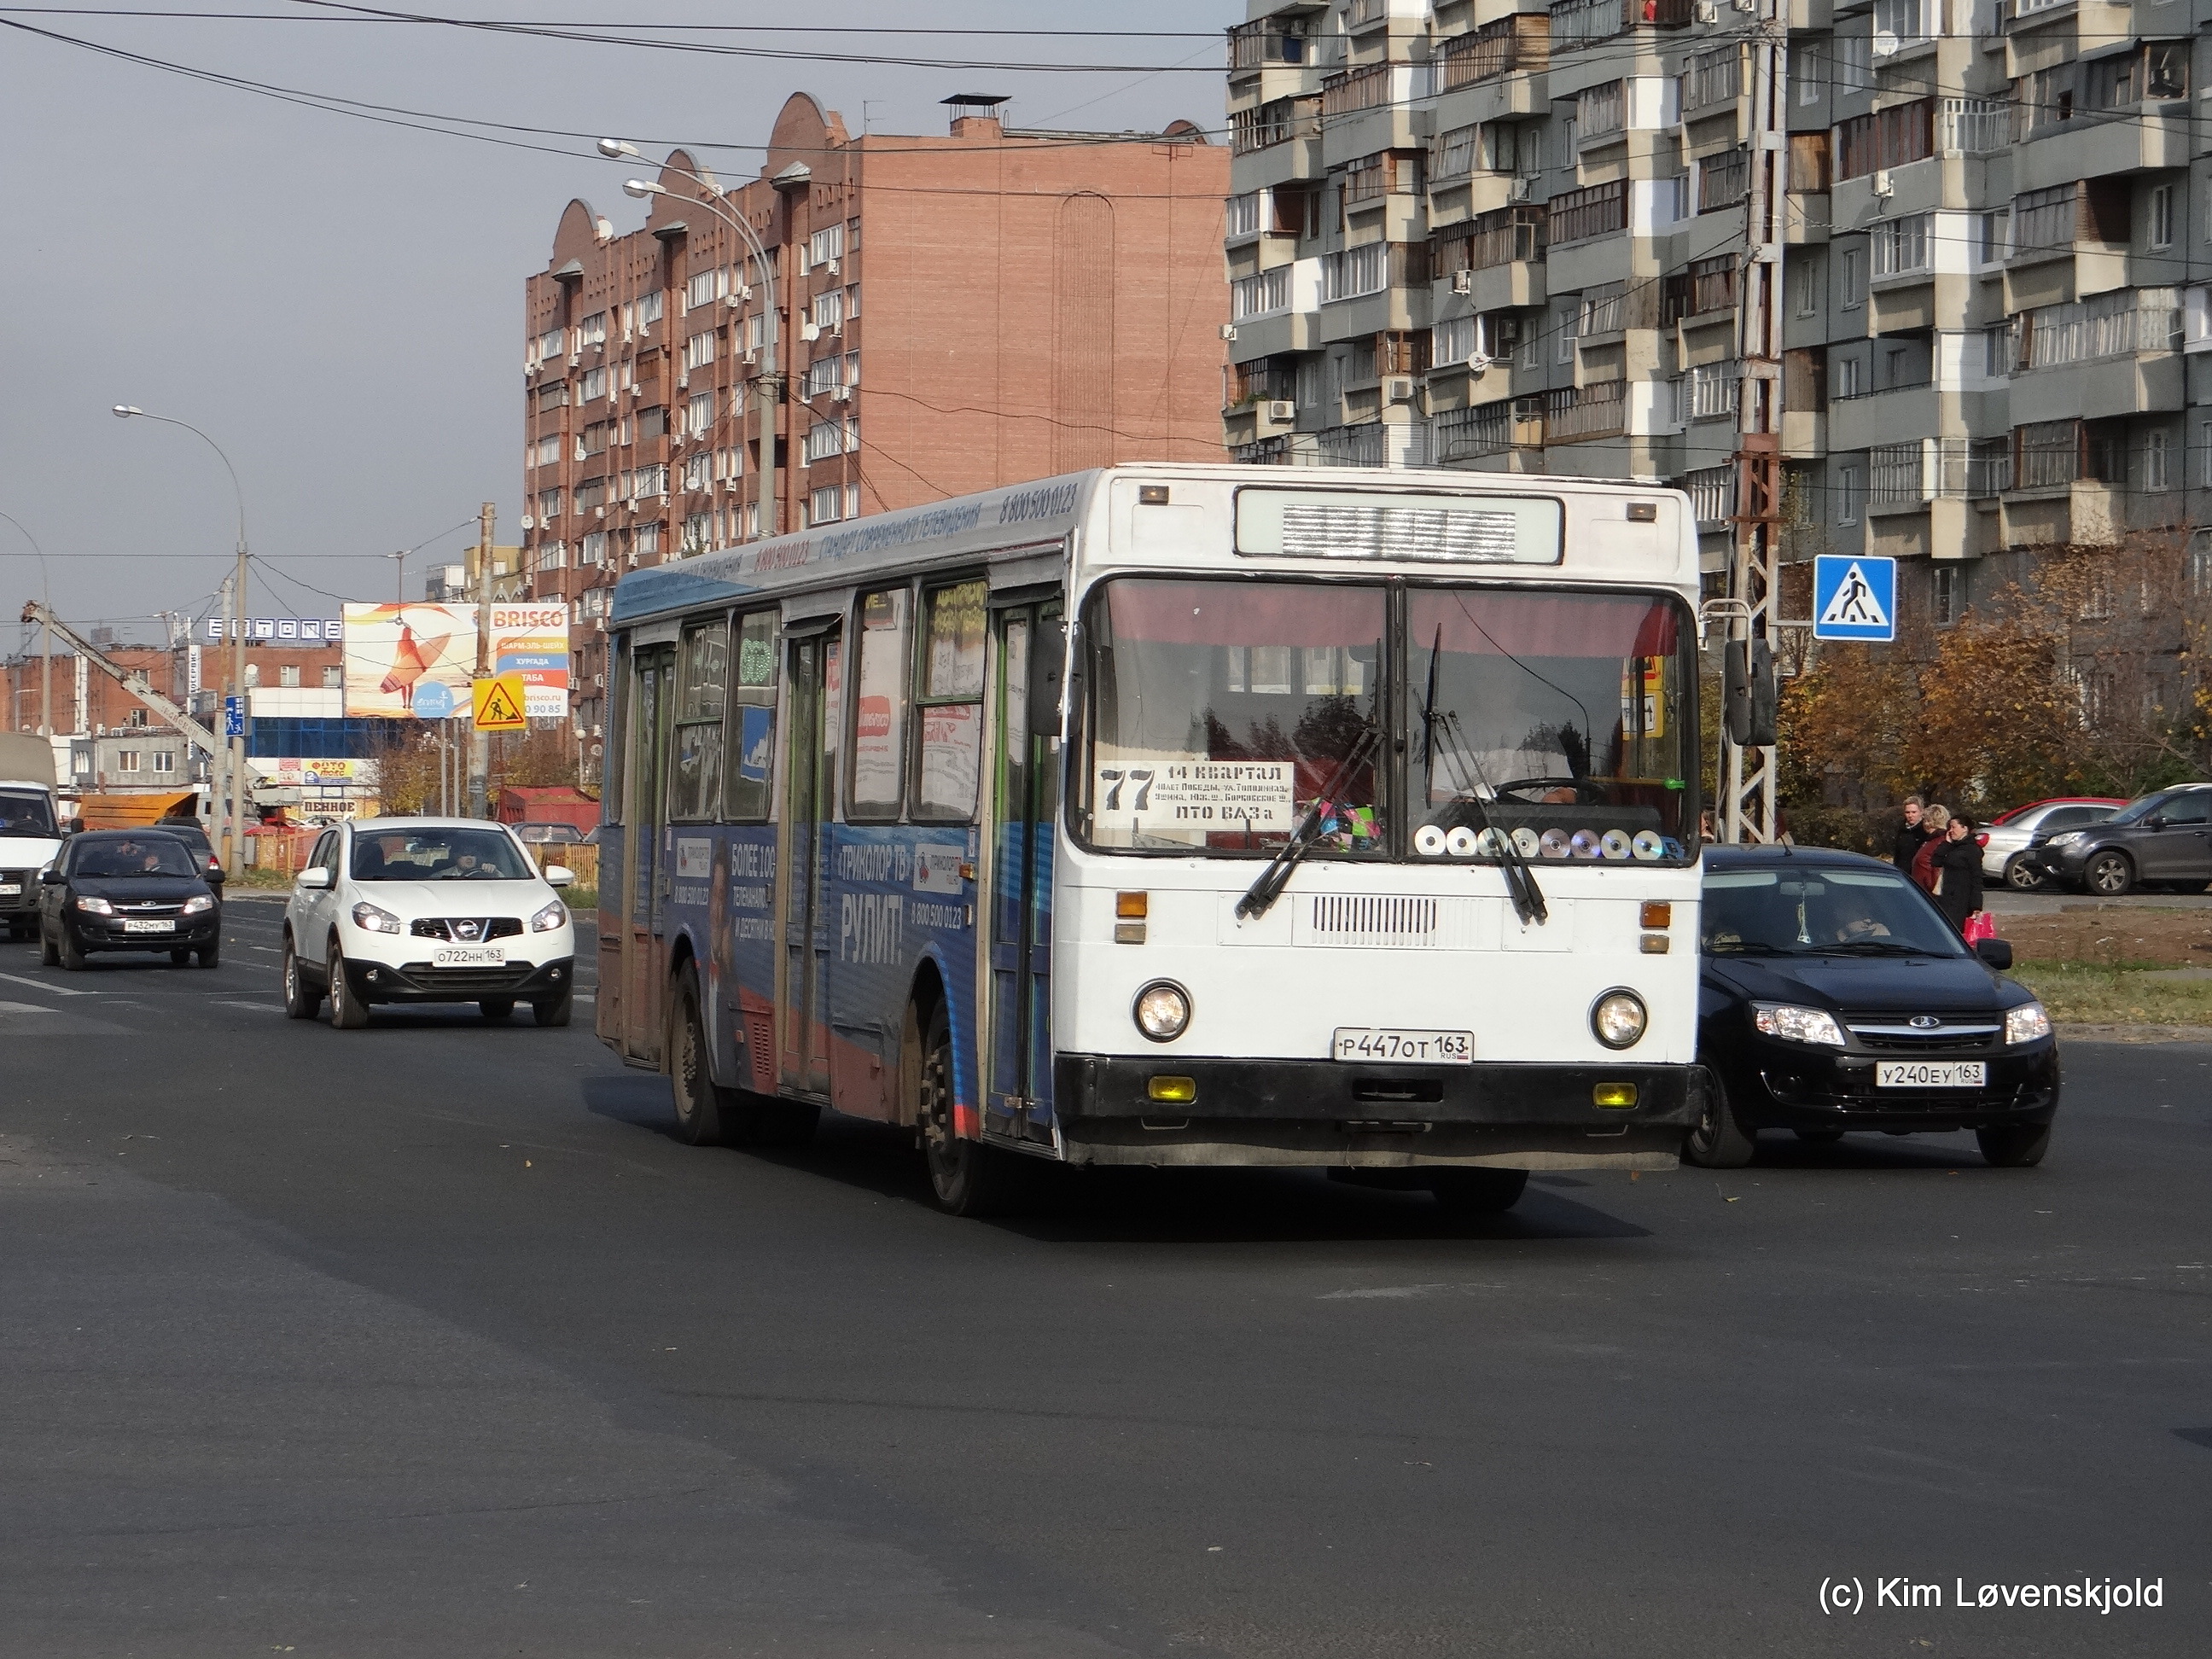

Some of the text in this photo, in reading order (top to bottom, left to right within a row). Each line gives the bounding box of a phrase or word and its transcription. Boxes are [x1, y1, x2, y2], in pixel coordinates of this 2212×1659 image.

[999, 482, 1078, 524] 8 800 500 0123
[493, 610, 564, 628] BRISCO
[501, 640, 565, 649] ШАРМ-ЭЛЬ-ШЕЙХ
[515, 657, 549, 666] ХУРГАДА
[521, 673, 544, 682] ТАБА
[533, 705, 545, 713] 90
[548, 705, 561, 713] 85
[311, 761, 346, 770] ФОТО
[1168, 765, 1187, 779] 14
[1101, 769, 1155, 811] 77
[305, 801, 355, 812] ПЕННОЕ
[1176, 806, 1213, 819] ПТО
[731, 843, 759, 877] БОЛЕЕ
[911, 902, 962, 930] 8 800 500 0123
[841, 894, 903, 966] РУЛИТ!
[438, 949, 501, 962] О722НН 163
[1343, 1035, 1465, 1058] Р447ОТ 163
[1883, 1064, 1980, 1084] У240ЕУ 163
